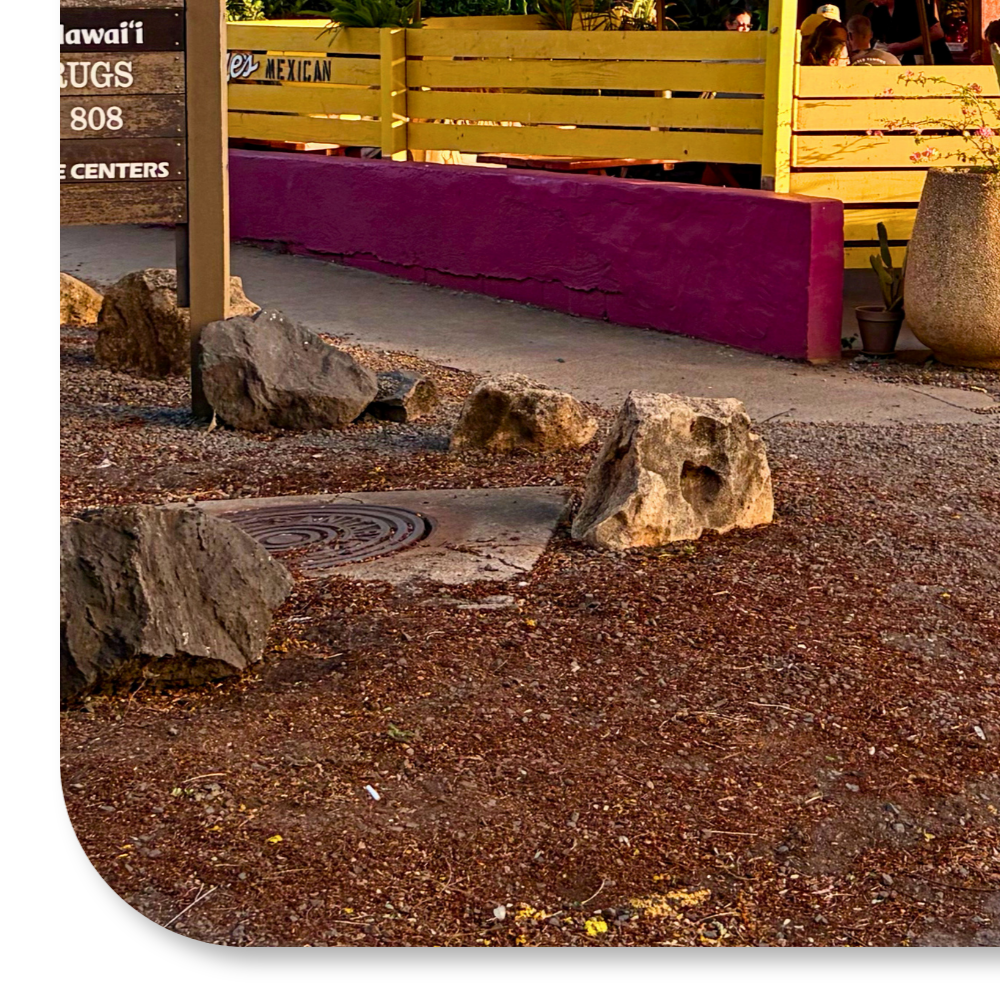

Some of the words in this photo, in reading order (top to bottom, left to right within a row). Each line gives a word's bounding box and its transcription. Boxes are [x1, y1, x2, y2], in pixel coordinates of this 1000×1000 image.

[59, 20, 144, 45] awai‘i
[265, 58, 331, 82] MEXICAN
[70, 106, 124, 131] 808
[70, 161, 169, 180] CENTERS
